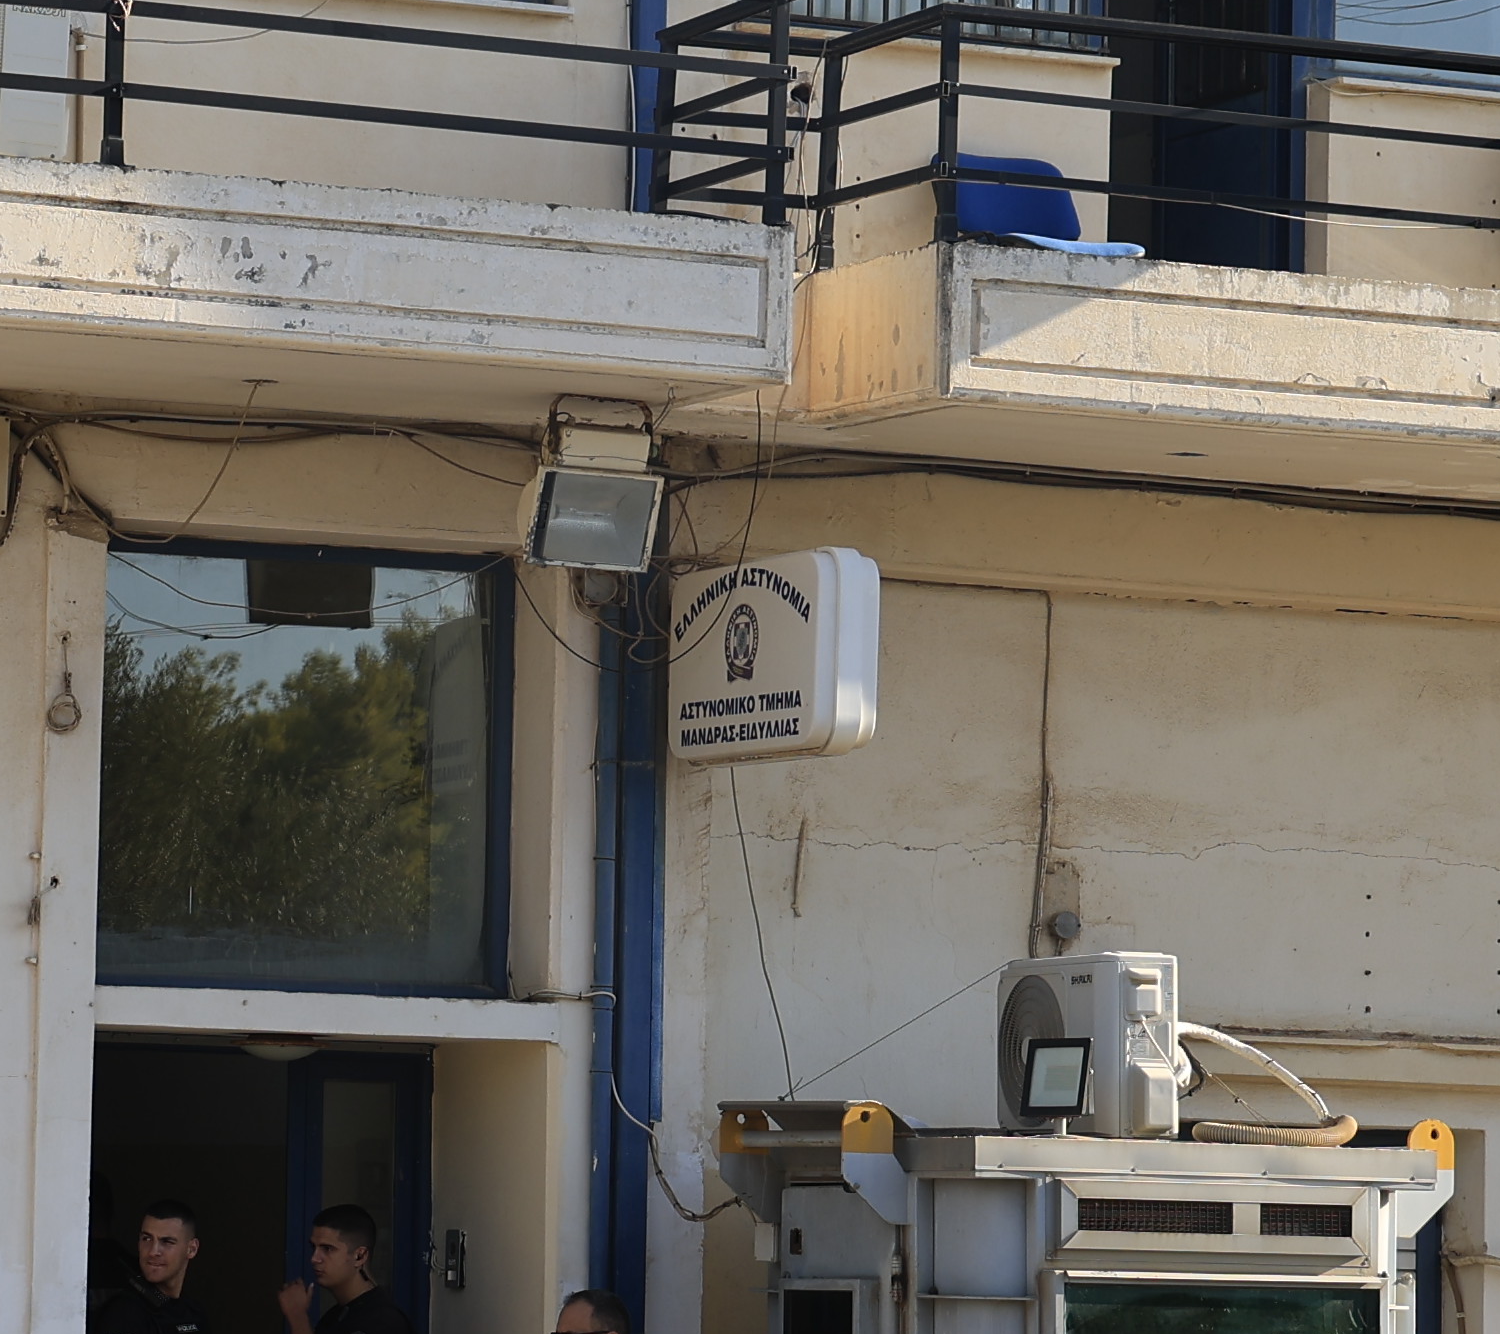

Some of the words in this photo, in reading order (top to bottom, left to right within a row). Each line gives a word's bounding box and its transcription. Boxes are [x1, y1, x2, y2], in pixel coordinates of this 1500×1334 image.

[674, 570, 737, 643] ΕΛΛΗΝΙΚΗ
[740, 567, 811, 624] ΑΣΤΥΝΟΜΙΑ
[680, 695, 755, 720] ΑΣΤΥΝΟΜΙΚΟ
[758, 689, 802, 712] ΤΜΗΜΑ
[681, 717, 800, 747] ΜΑΝΔΡΑΣ-ΕΙΔΥΛΛΙΑΣ
